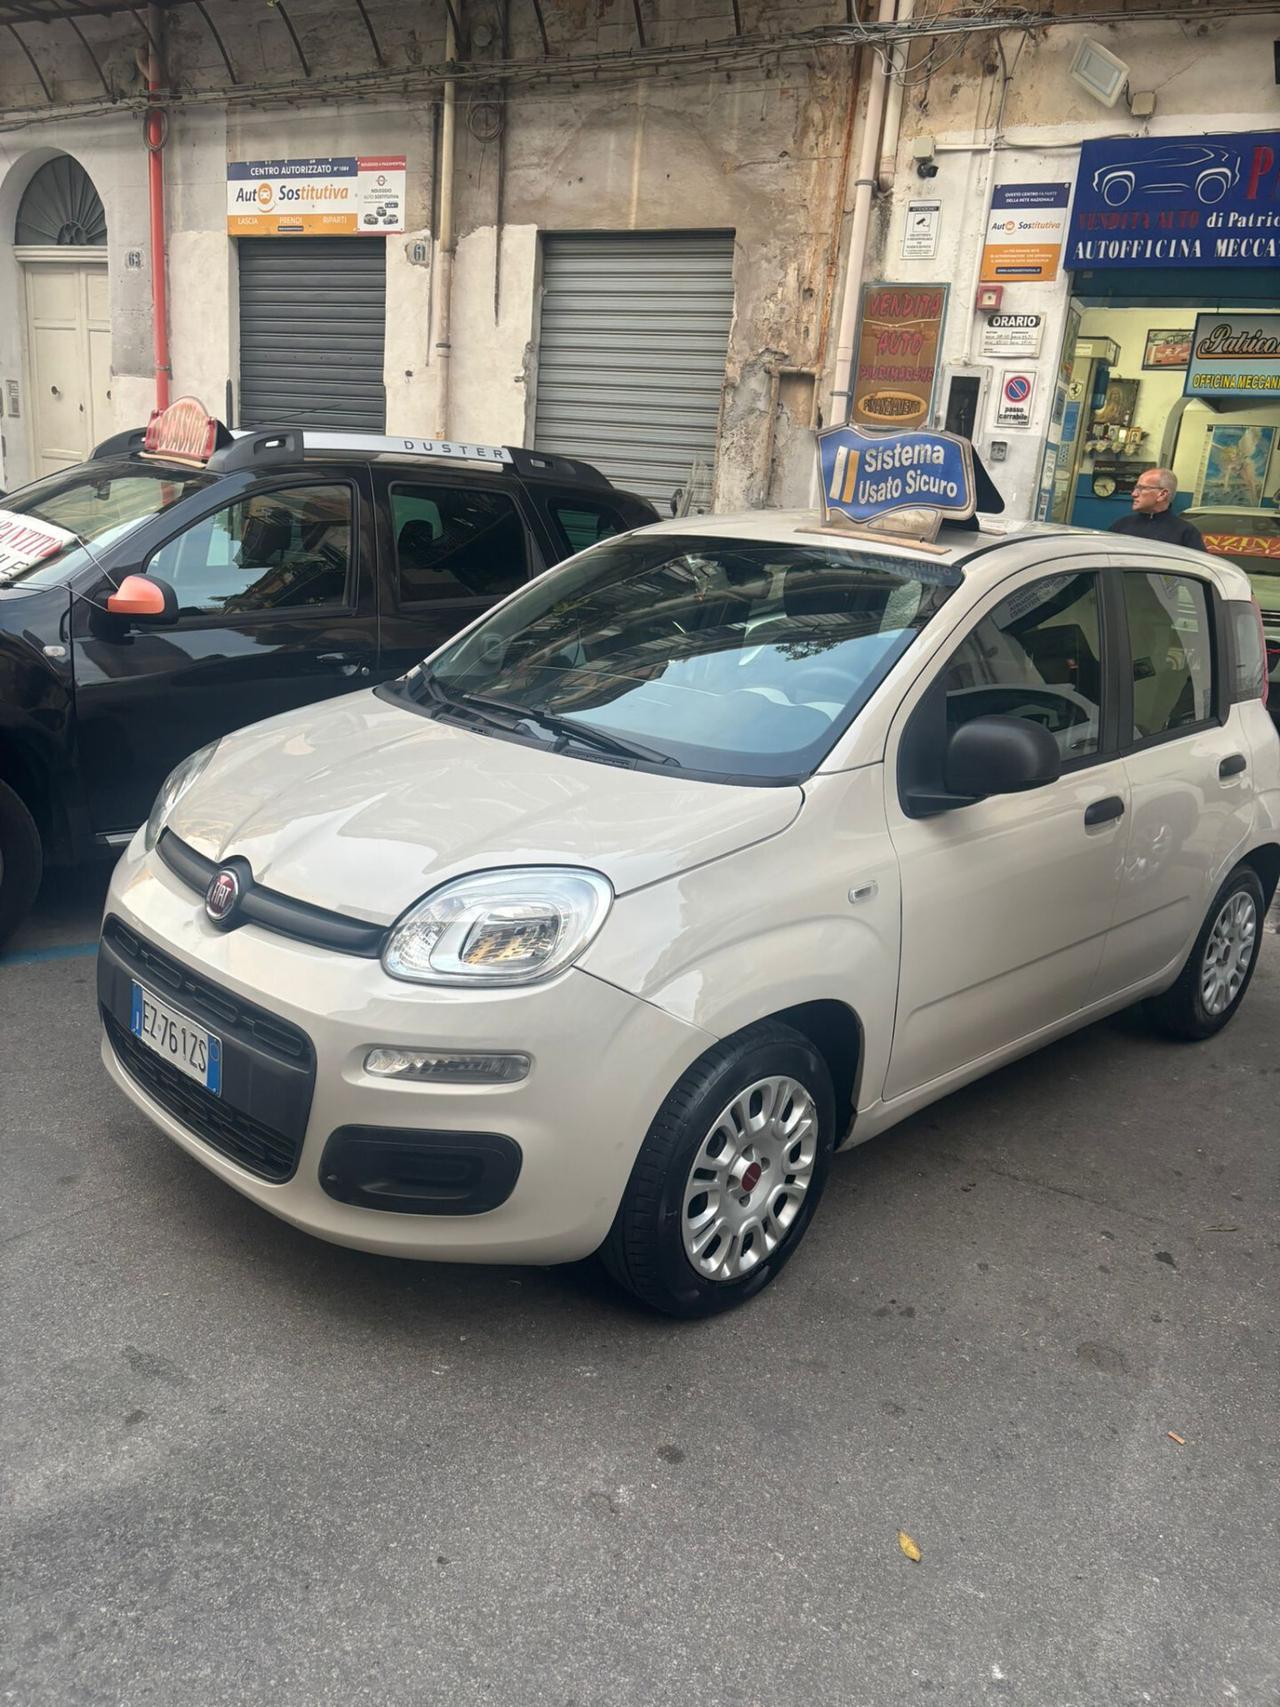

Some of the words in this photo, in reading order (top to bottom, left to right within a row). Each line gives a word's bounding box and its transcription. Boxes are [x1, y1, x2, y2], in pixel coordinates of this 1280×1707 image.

[250, 167, 280, 176] CENTRO
[281, 165, 332, 175] AUTORIZZATO
[279, 185, 349, 201] Sostitutiva
[238, 217, 258, 225] LASCIA
[279, 216, 303, 224] PRENDI
[321, 216, 347, 224] RIPARTI
[1018, 221, 1061, 230] Sostitutiva
[1079, 210, 1149, 229] VENDITA
[1158, 210, 1200, 228] AUTO
[1206, 212, 1223, 227] di
[413, 243, 426, 261] 61
[1074, 239, 1201, 259] AUTOFFICINA
[1214, 238, 1280, 257] MECCA
[870, 292, 942, 319] VENDITA
[992, 316, 1036, 327] ORARIO
[877, 330, 923, 356] AUTO
[1193, 373, 1237, 389] OFFICINA
[404, 440, 504, 459] DUSTER
[864, 443, 945, 472] Sistema
[858, 476, 902, 504] Usato
[905, 470, 958, 498] Sicuro
[211, 881, 232, 907] FIAT
